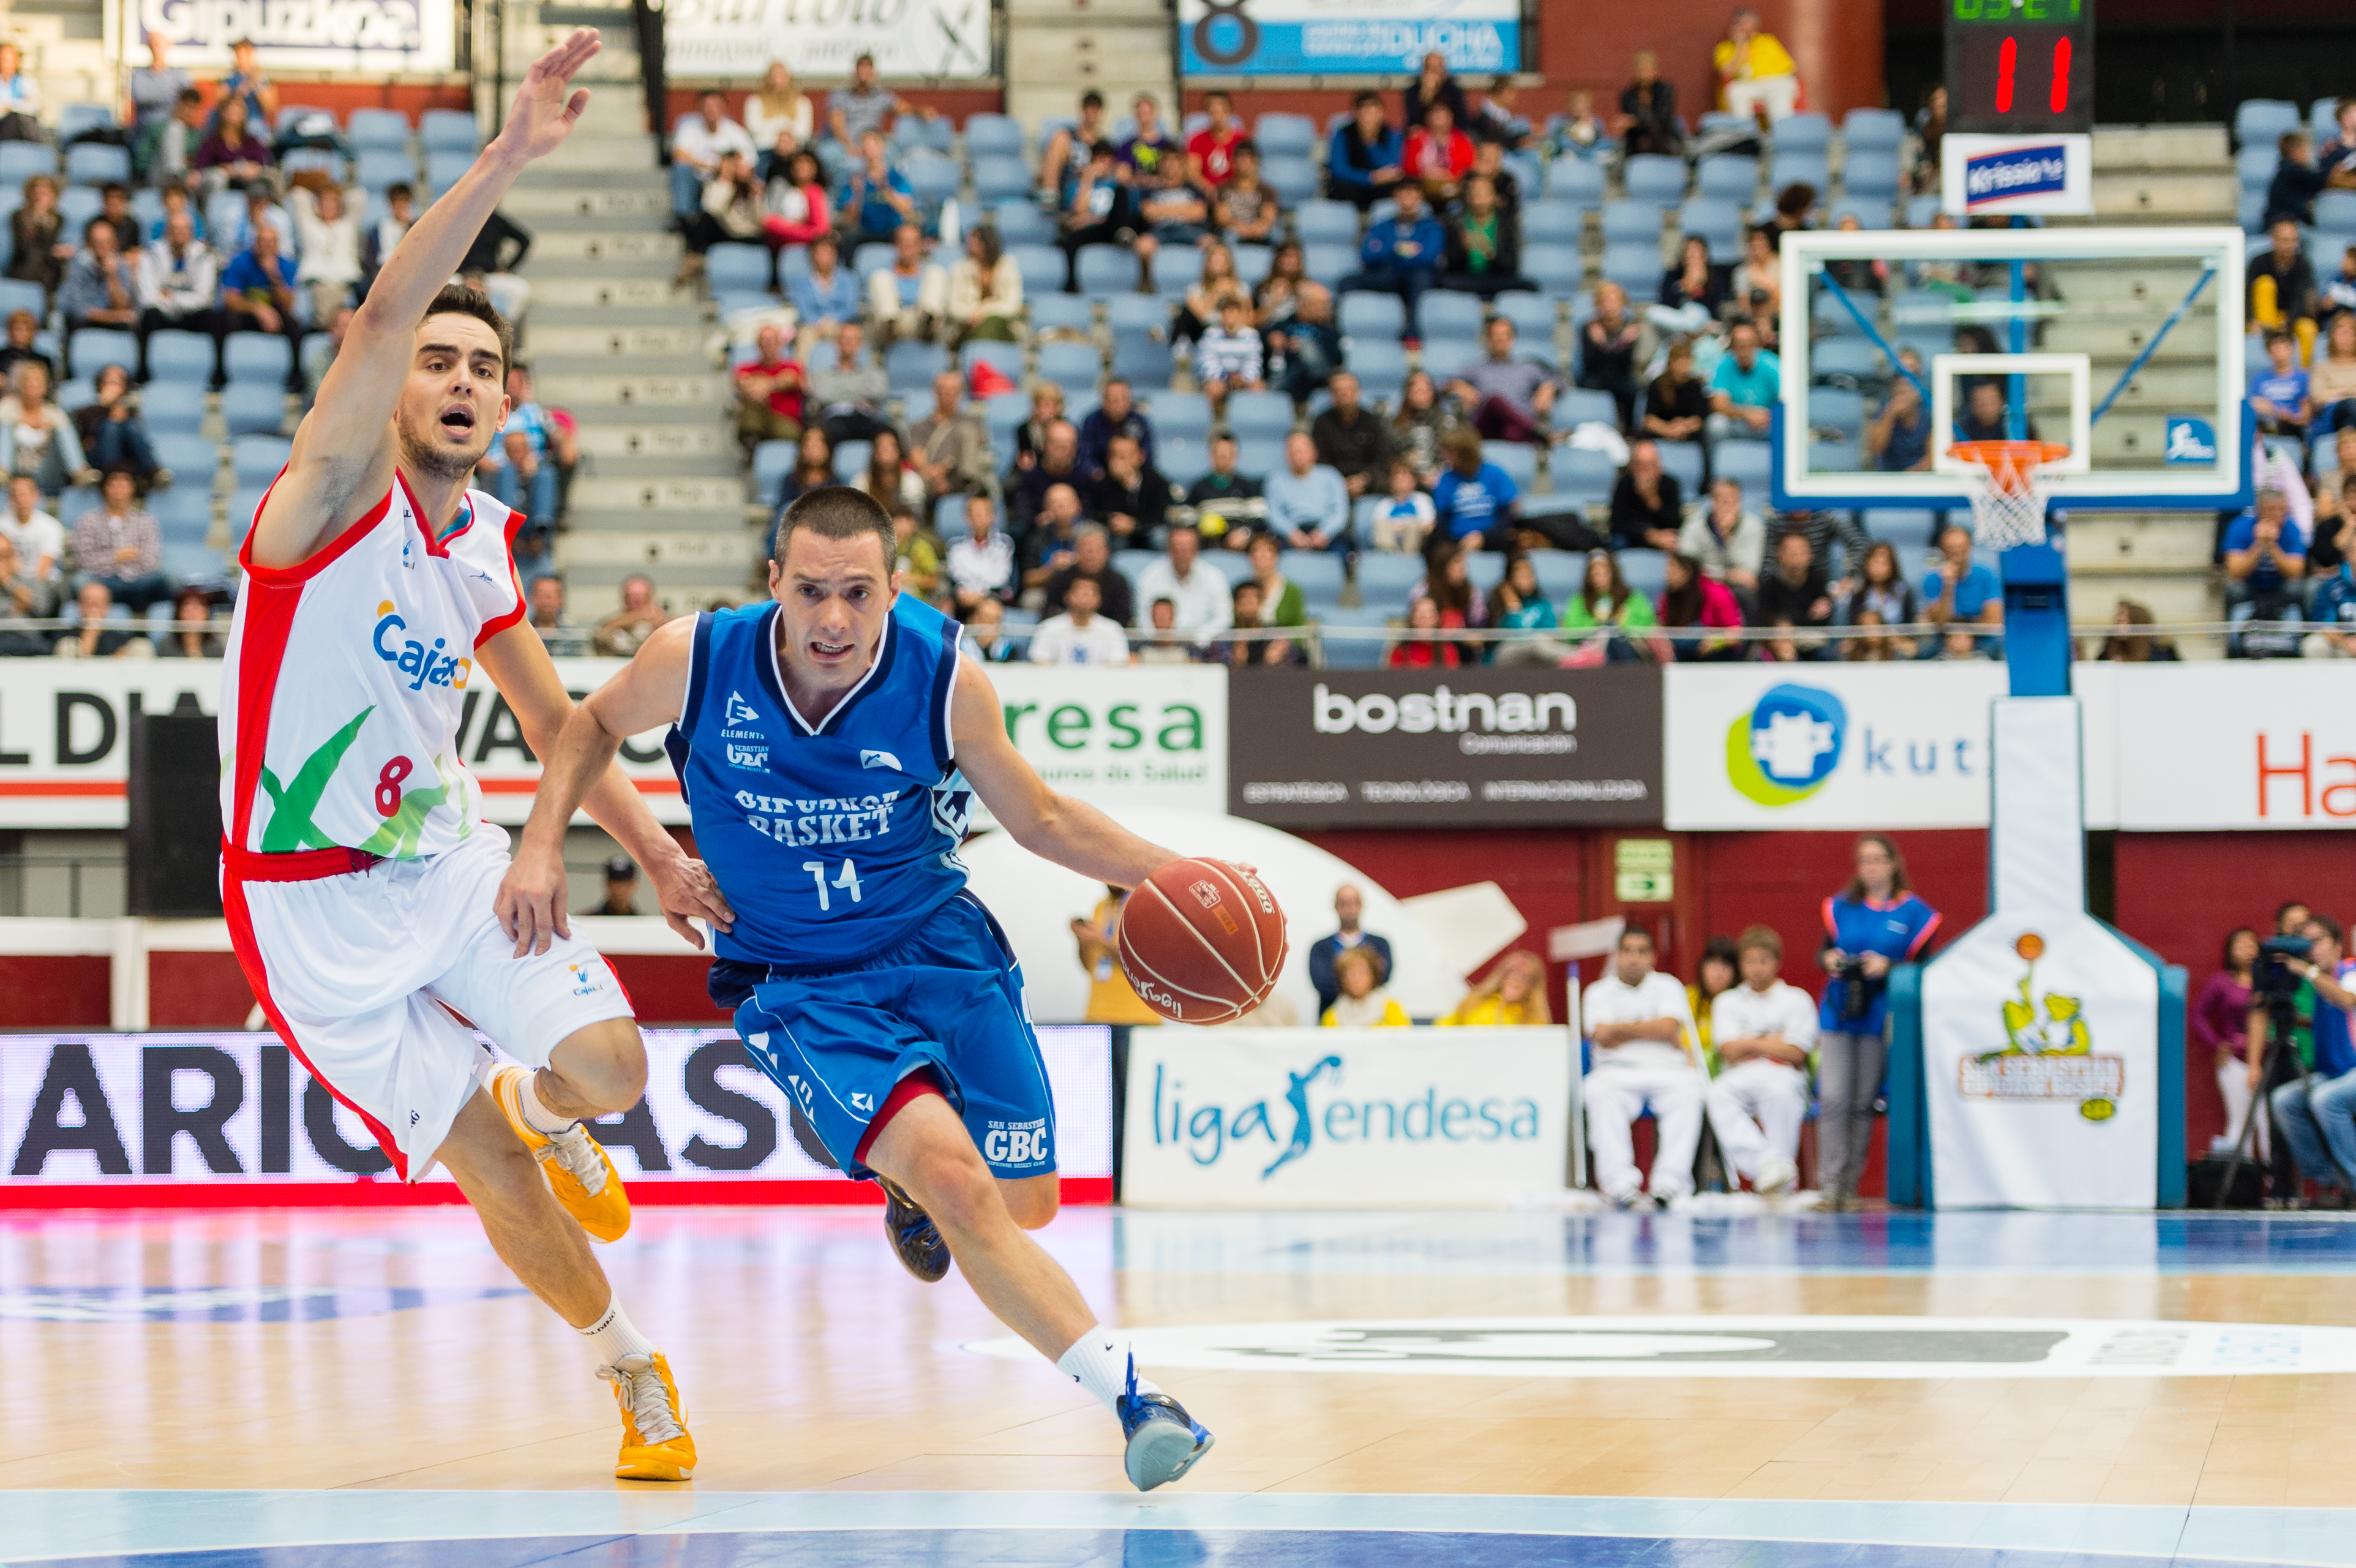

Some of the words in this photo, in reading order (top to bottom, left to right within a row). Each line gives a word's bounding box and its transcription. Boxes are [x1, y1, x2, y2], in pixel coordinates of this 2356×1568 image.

[1996, 37, 2072, 113] 11
[1313, 682, 1578, 733] bostnan
[721, 729, 765, 740] ELEMENTS
[374, 755, 413, 817] 8
[746, 806, 894, 847] BASKET
[803, 858, 865, 911] 14
[988, 1120, 1005, 1129] SAN
[1154, 1063, 1276, 1166] liga
[1324, 1086, 1540, 1142] endesa
[985, 1127, 1048, 1163] GBC
